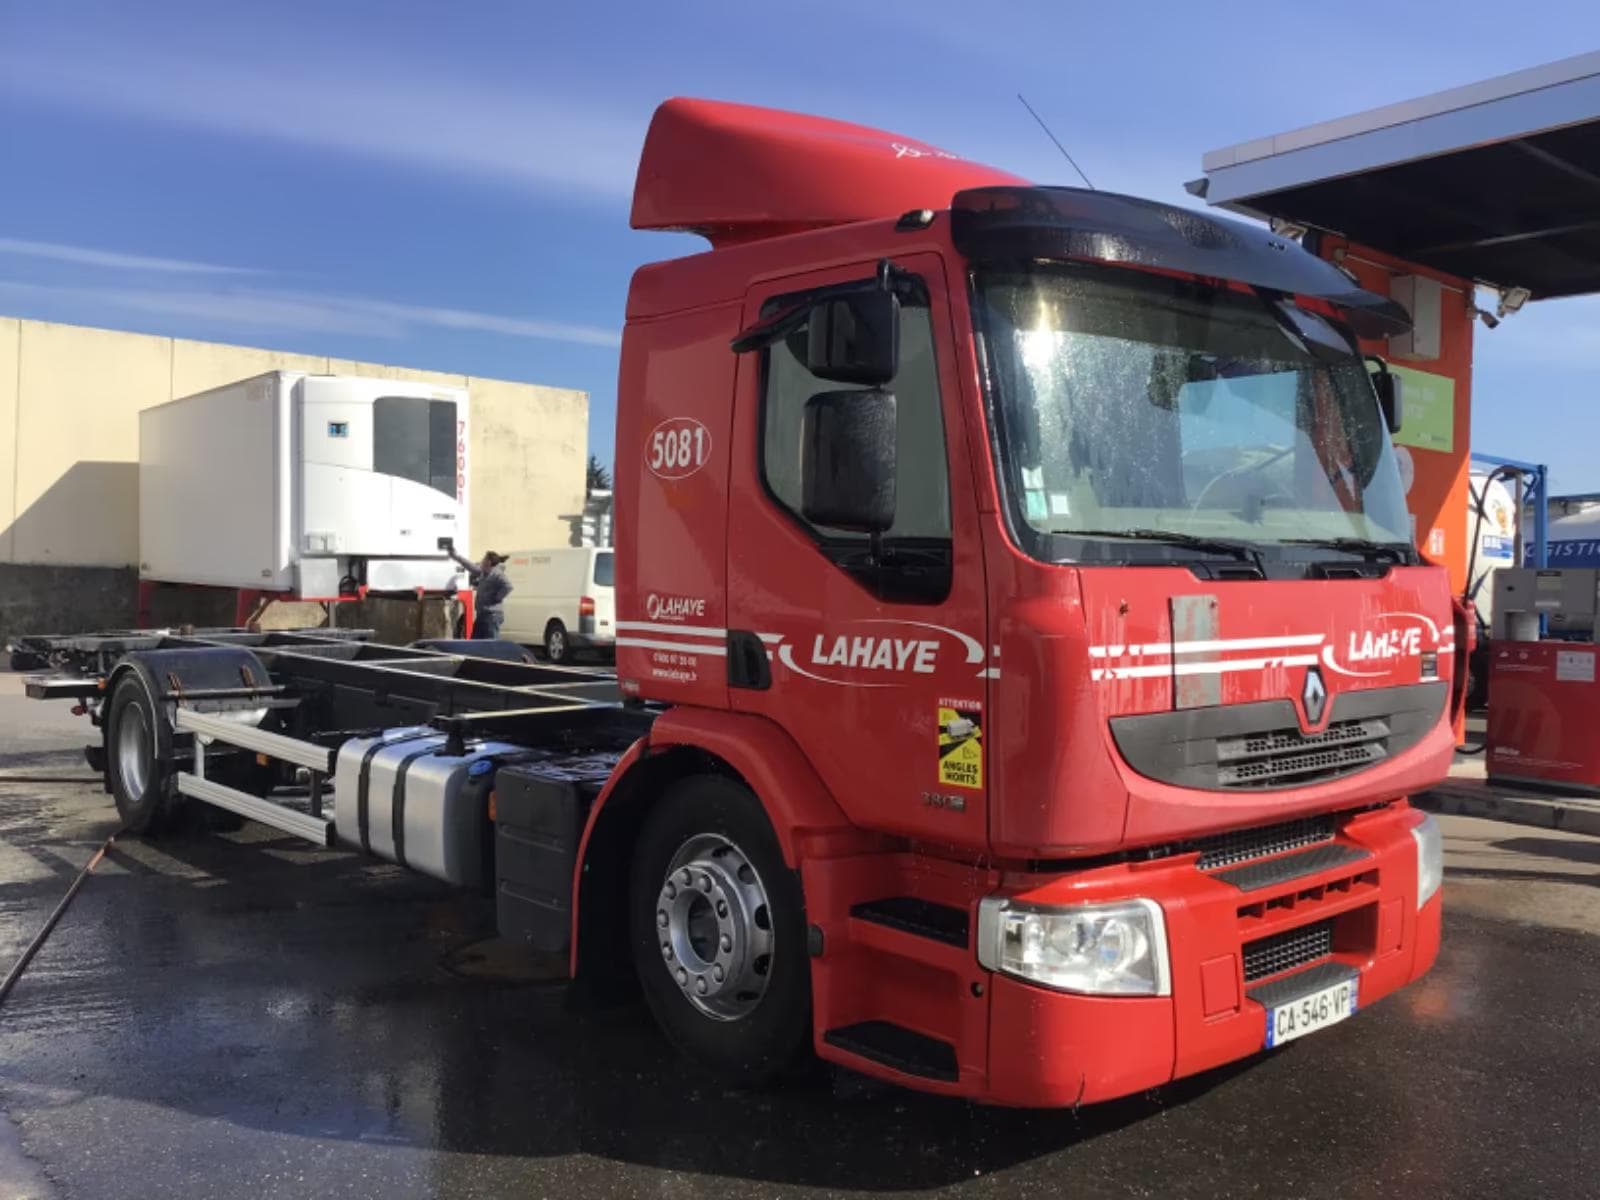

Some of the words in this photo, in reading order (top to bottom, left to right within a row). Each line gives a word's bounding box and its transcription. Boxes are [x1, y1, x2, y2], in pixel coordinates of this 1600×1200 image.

[652, 427, 703, 469] 5081
[812, 634, 940, 673] LAHAYE
[1348, 627, 1422, 662] LAHAYE
[943, 760, 978, 774] ANGLES
[945, 771, 977, 785] MORTS
